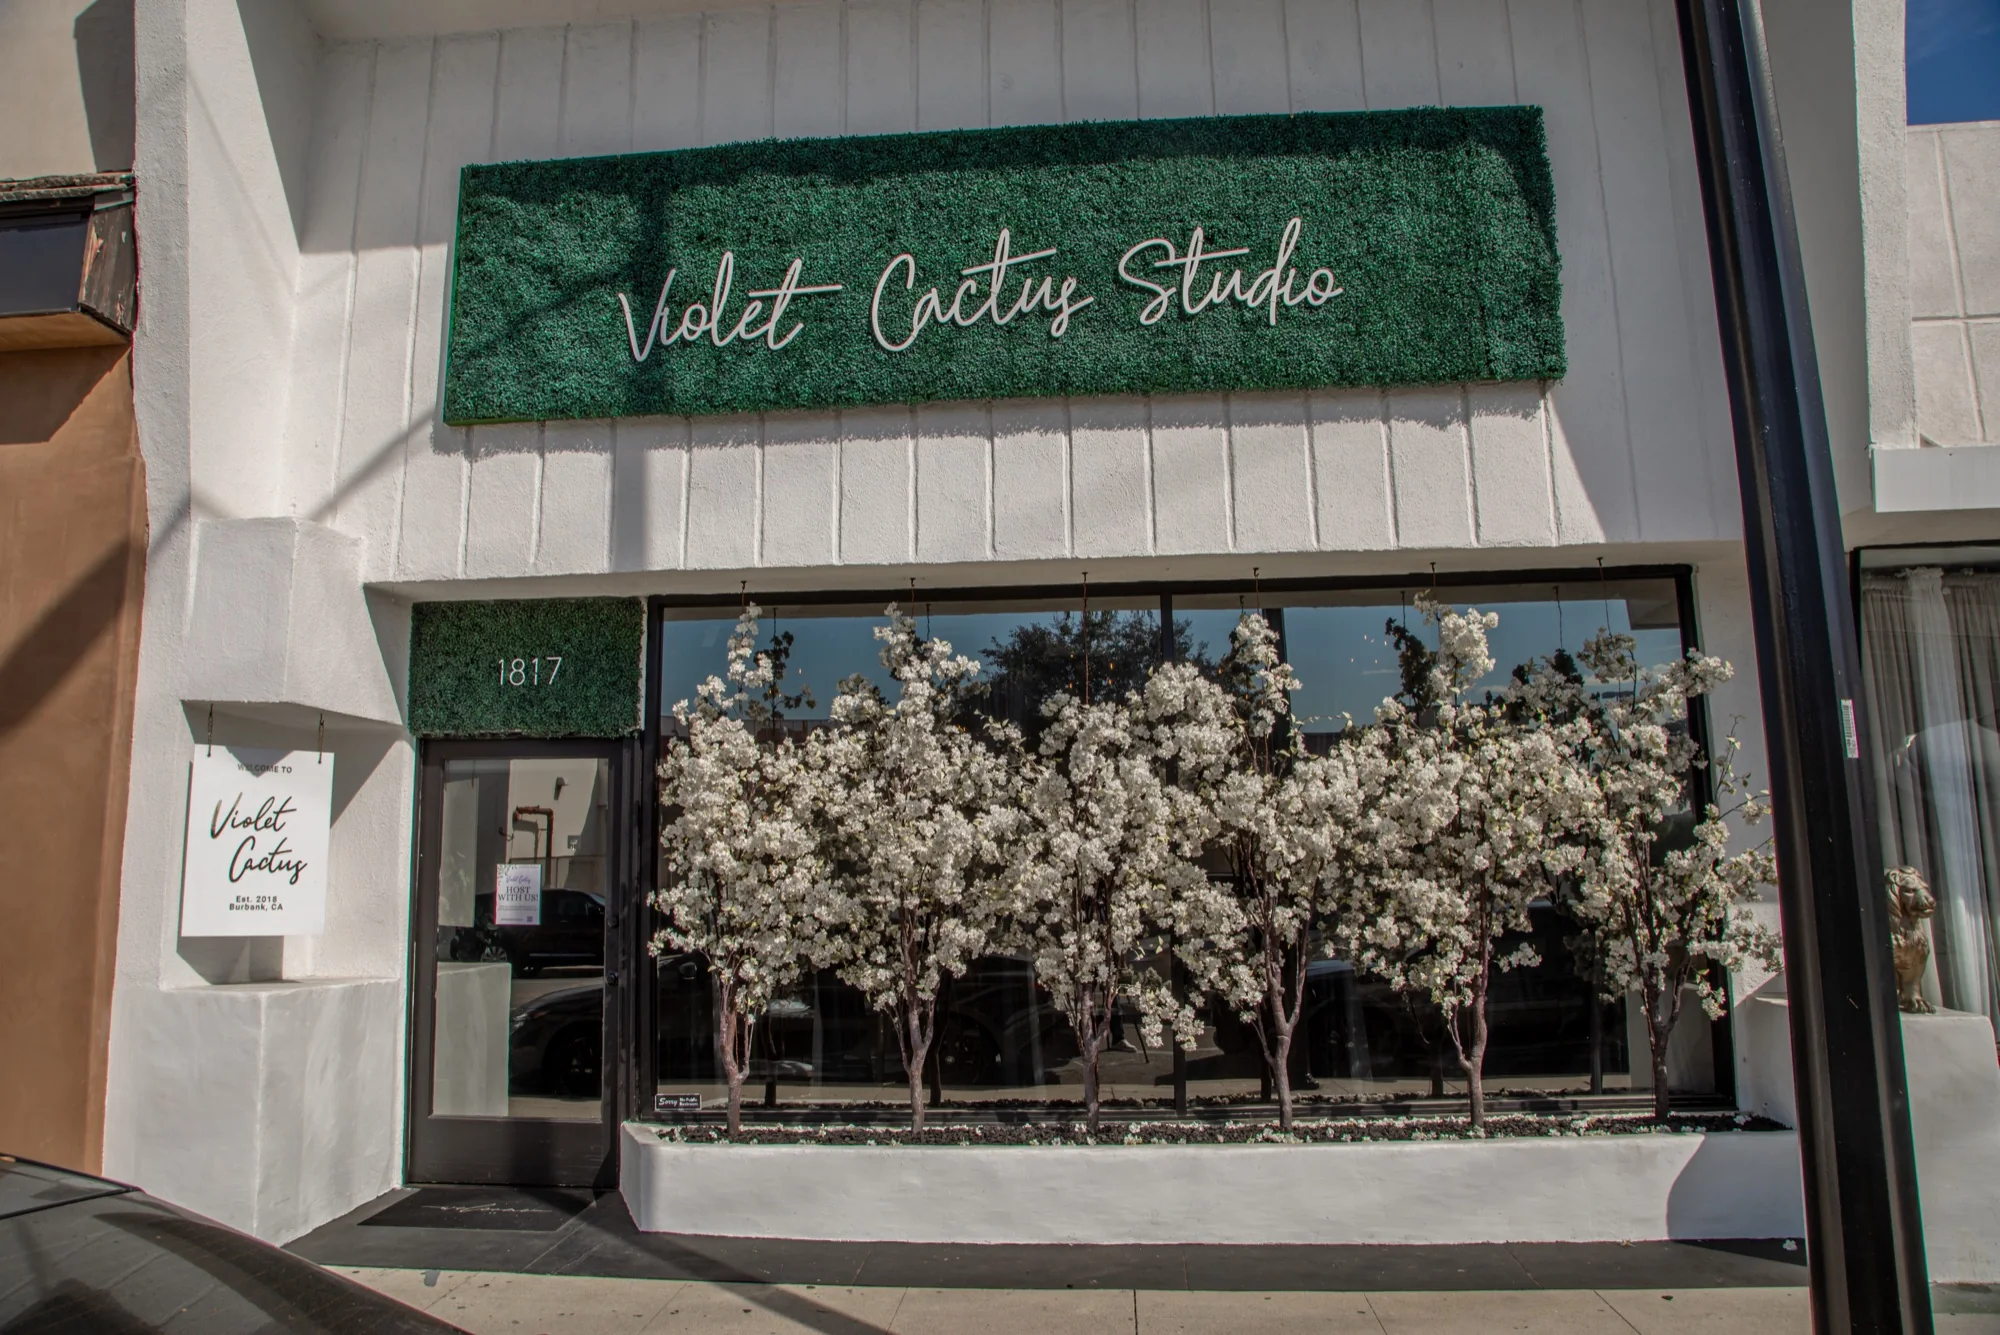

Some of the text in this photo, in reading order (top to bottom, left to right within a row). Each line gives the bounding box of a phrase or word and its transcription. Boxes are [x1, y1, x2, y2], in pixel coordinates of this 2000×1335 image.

[618, 217, 1344, 362] Violet Cactus Studio
[498, 656, 562, 686] 1817
[237, 763, 293, 774] WELCOME TO
[210, 792, 297, 839] Violet
[228, 835, 308, 885] Cactus
[506, 886, 530, 894] HOST
[236, 895, 278, 903] Est. 2018
[498, 893, 522, 901] WITH
[229, 903, 283, 911] Burbank, CA
[658, 1097, 678, 1107] Sorry
